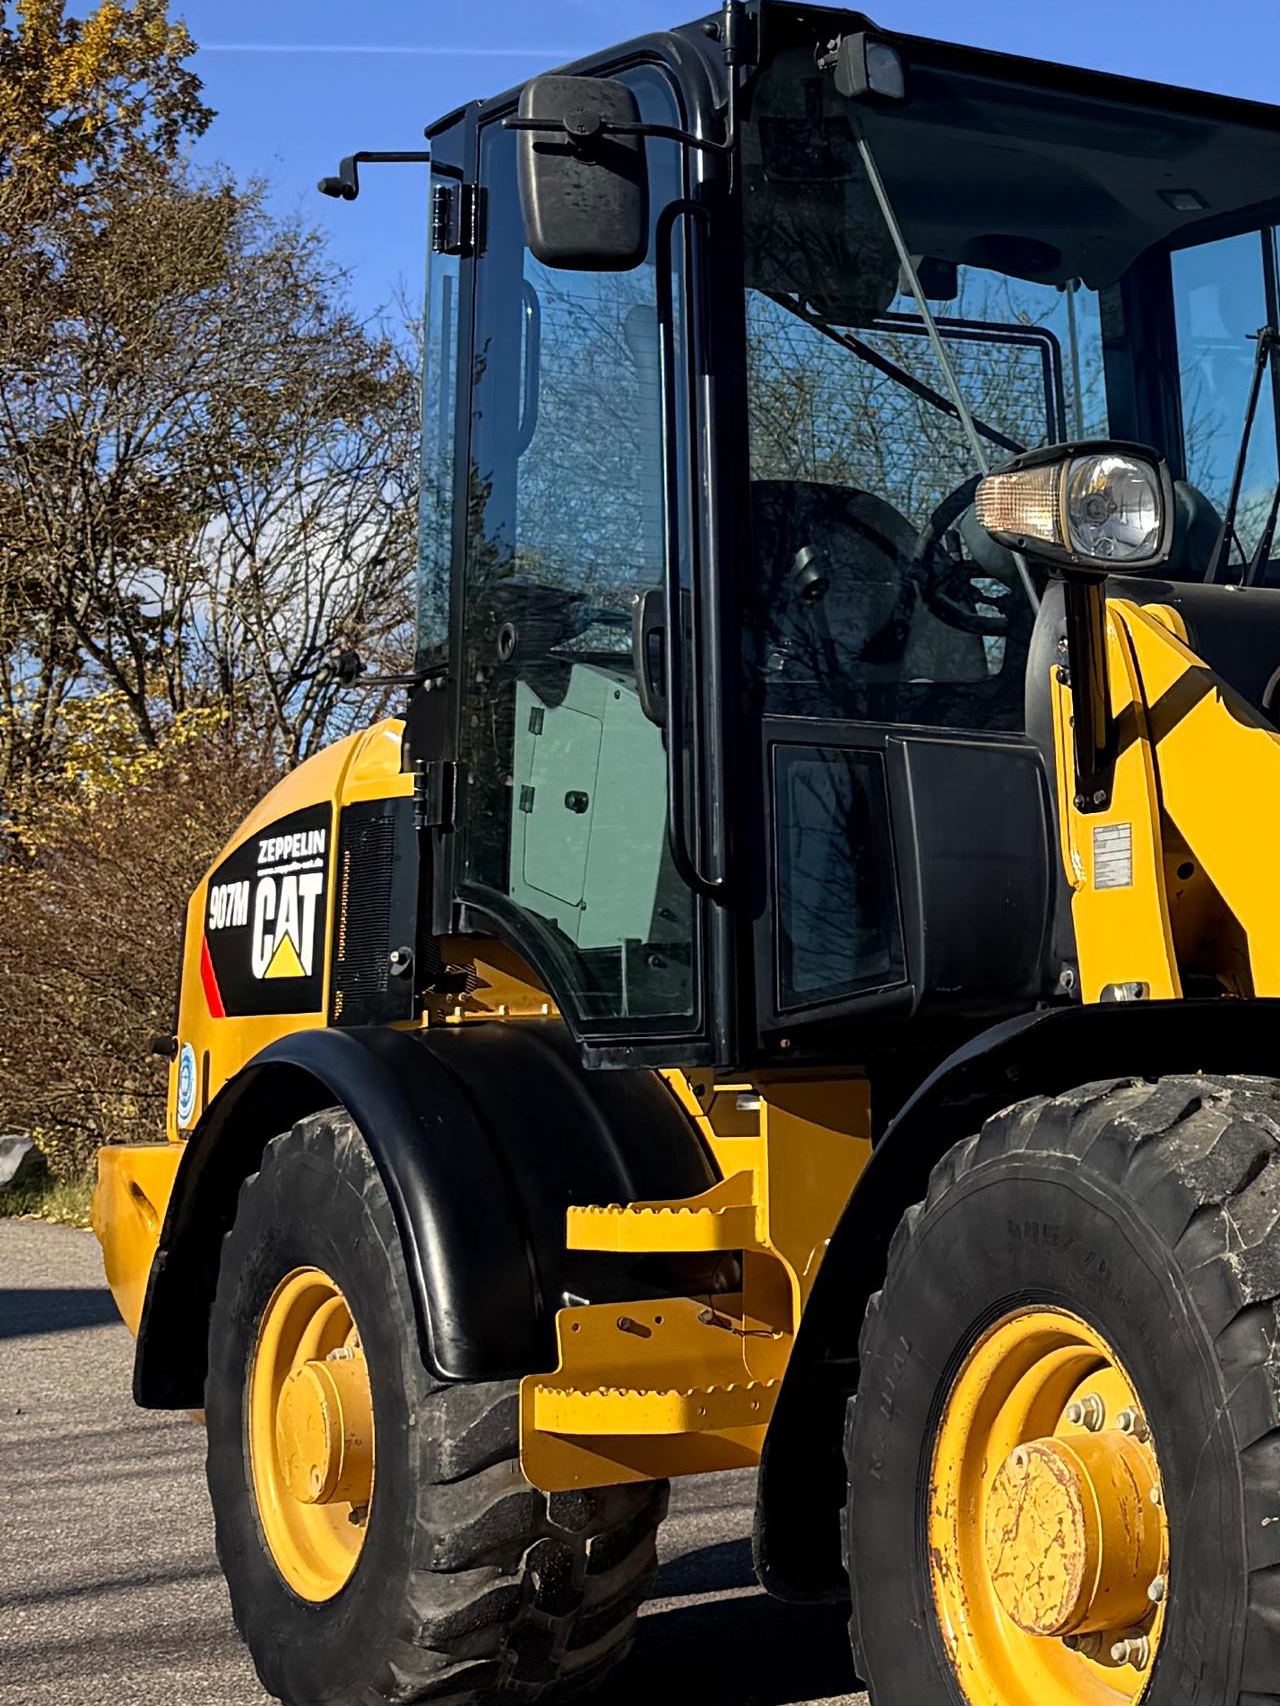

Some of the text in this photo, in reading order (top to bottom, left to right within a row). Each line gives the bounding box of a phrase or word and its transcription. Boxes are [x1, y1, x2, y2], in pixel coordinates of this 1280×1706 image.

[257, 829, 326, 864] ZEPPELIN
[209, 881, 250, 930] 907M
[252, 872, 323, 979] CAT
